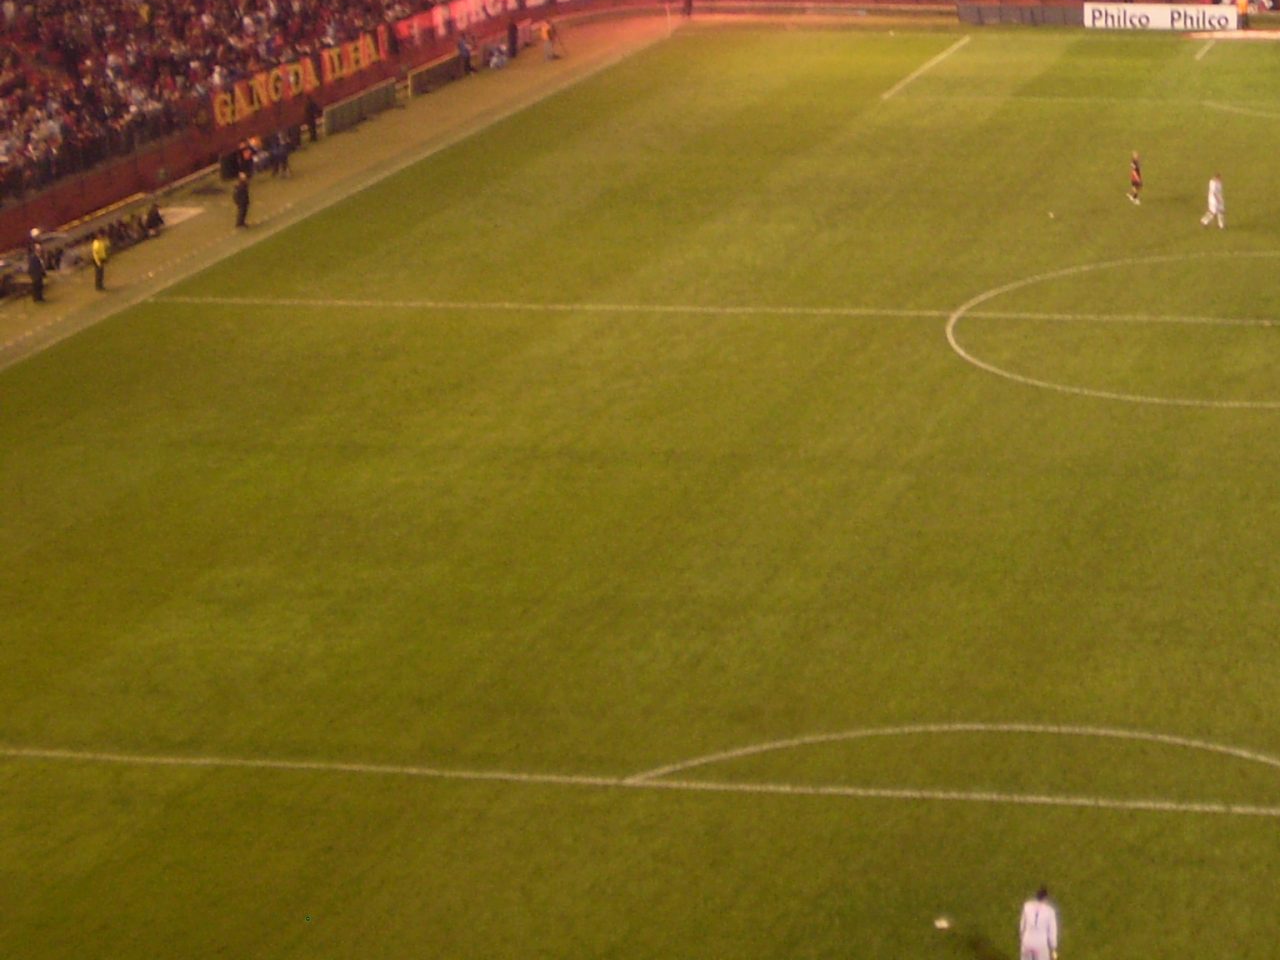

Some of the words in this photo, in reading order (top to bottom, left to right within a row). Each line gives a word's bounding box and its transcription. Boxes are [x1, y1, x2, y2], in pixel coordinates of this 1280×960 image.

[1092, 7, 1150, 28] Philco
[1170, 9, 1229, 30] Philco
[214, 66, 284, 126] GANG
[286, 57, 319, 98] DA
